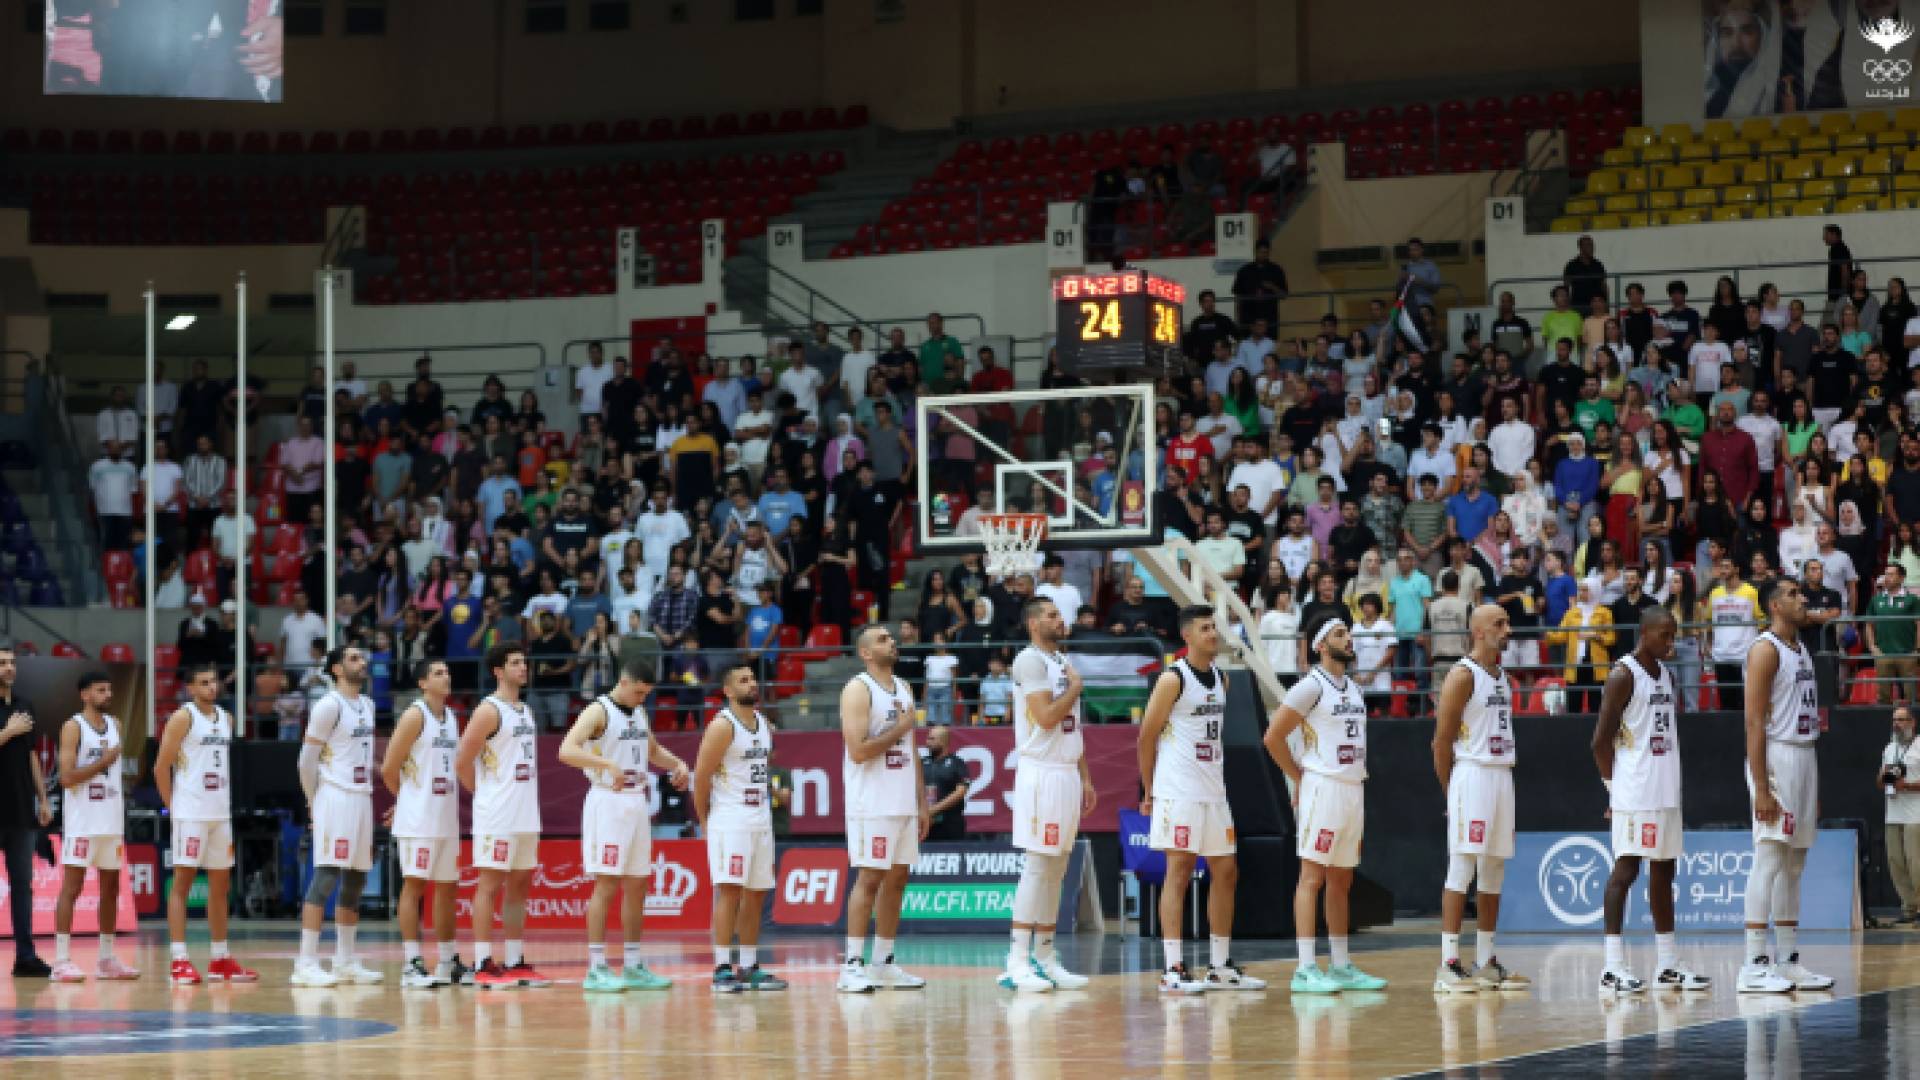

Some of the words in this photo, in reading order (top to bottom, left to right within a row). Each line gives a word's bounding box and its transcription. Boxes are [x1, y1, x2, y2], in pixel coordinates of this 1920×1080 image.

[1493, 202, 1513, 220] D1
[774, 230, 793, 246] D1
[1055, 230, 1073, 247] D1
[1223, 220, 1244, 239] D1
[1080, 299, 1122, 341] 24
[1154, 303, 1176, 344] 24
[785, 869, 837, 903] CFI
